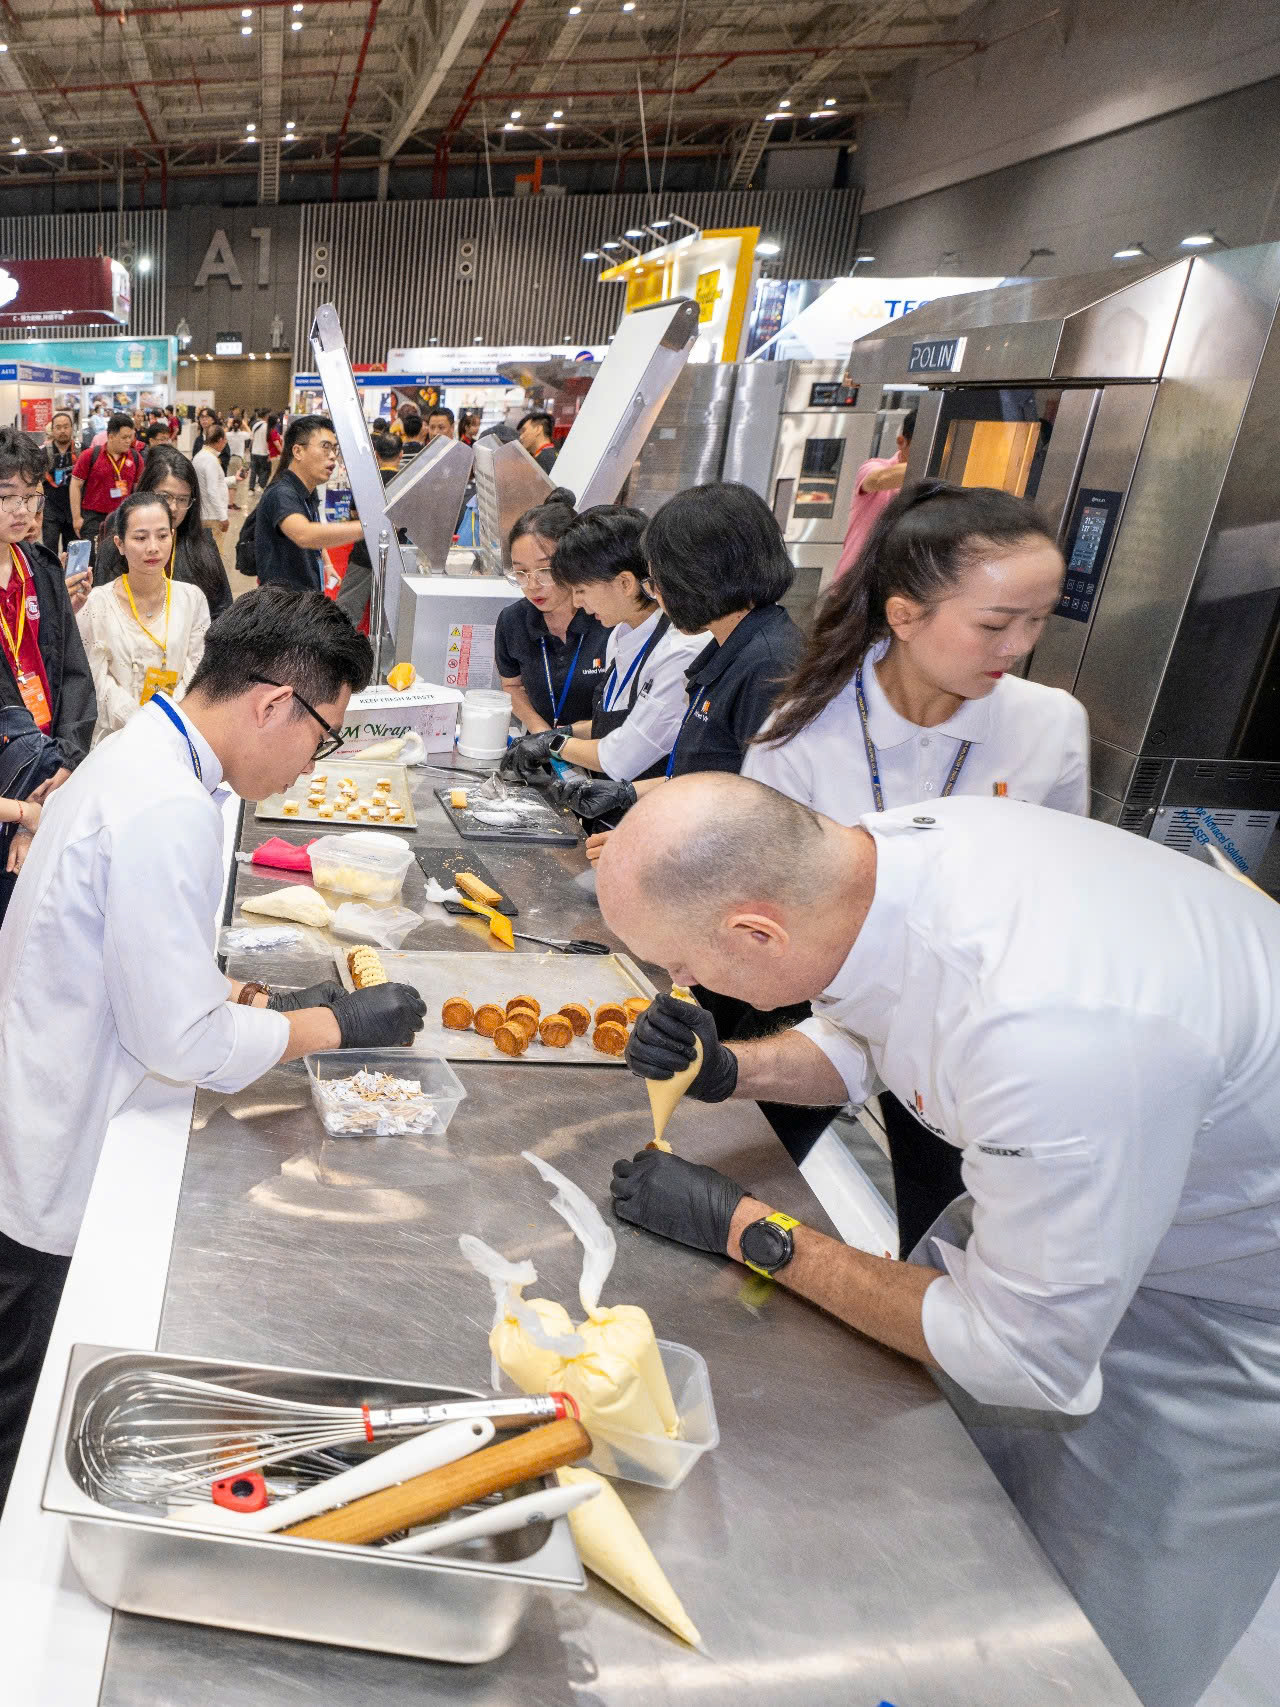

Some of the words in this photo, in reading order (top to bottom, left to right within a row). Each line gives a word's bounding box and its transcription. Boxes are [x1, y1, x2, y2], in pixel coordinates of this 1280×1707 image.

[194, 227, 272, 287] A1
[910, 344, 955, 369] POLIN
[363, 723, 412, 737] Wrap
[1186, 820, 1210, 846] LASER
[1203, 814, 1231, 845] Novacel
[1223, 841, 1249, 873] Solution
